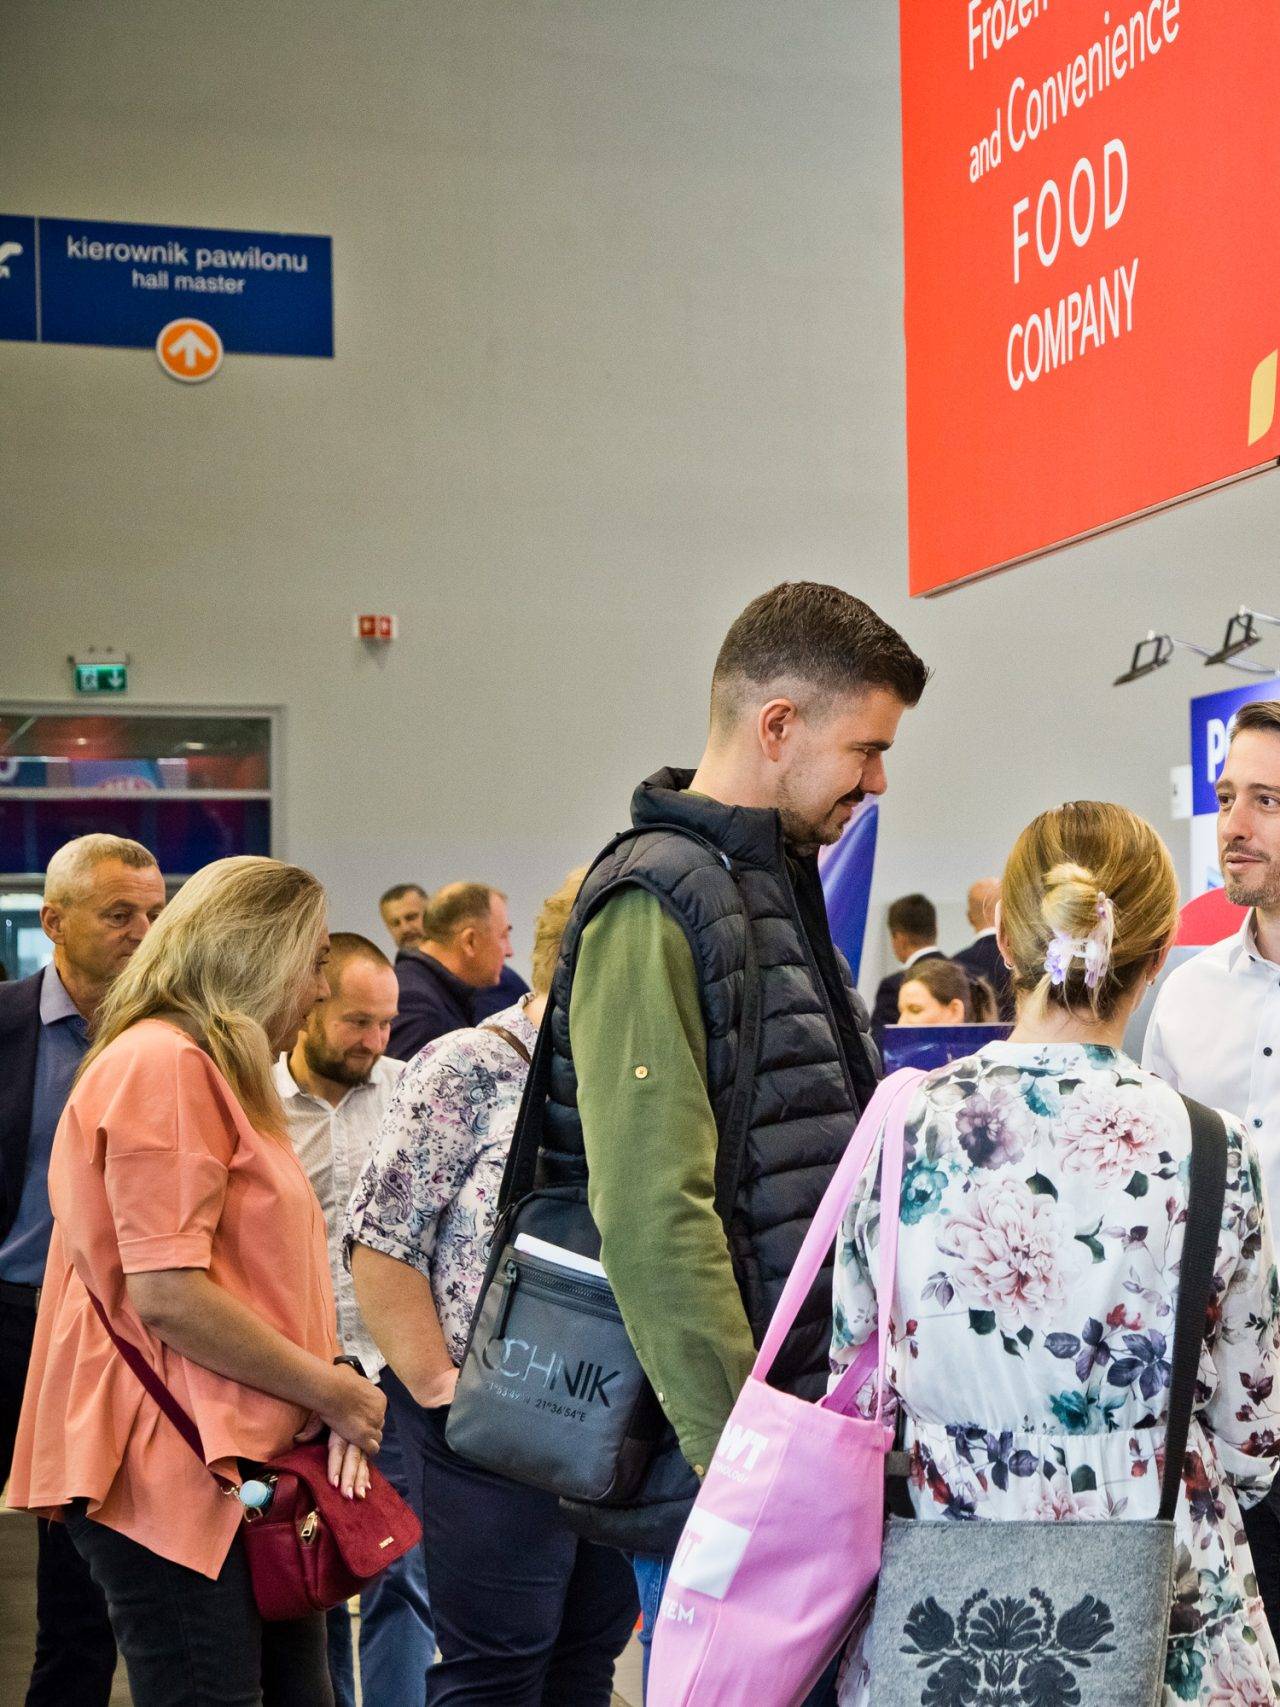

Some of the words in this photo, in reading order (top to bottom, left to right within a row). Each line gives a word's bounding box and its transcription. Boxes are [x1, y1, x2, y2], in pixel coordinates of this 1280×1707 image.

[969, 108, 1002, 183] and
[1006, 0, 1181, 153] Convenience
[66, 234, 189, 266] kierownik
[195, 246, 308, 273] pawilonu
[1012, 138, 1129, 285] FOOD
[131, 268, 169, 289] hall
[174, 273, 246, 294] master
[1006, 258, 1139, 391] COMPANY
